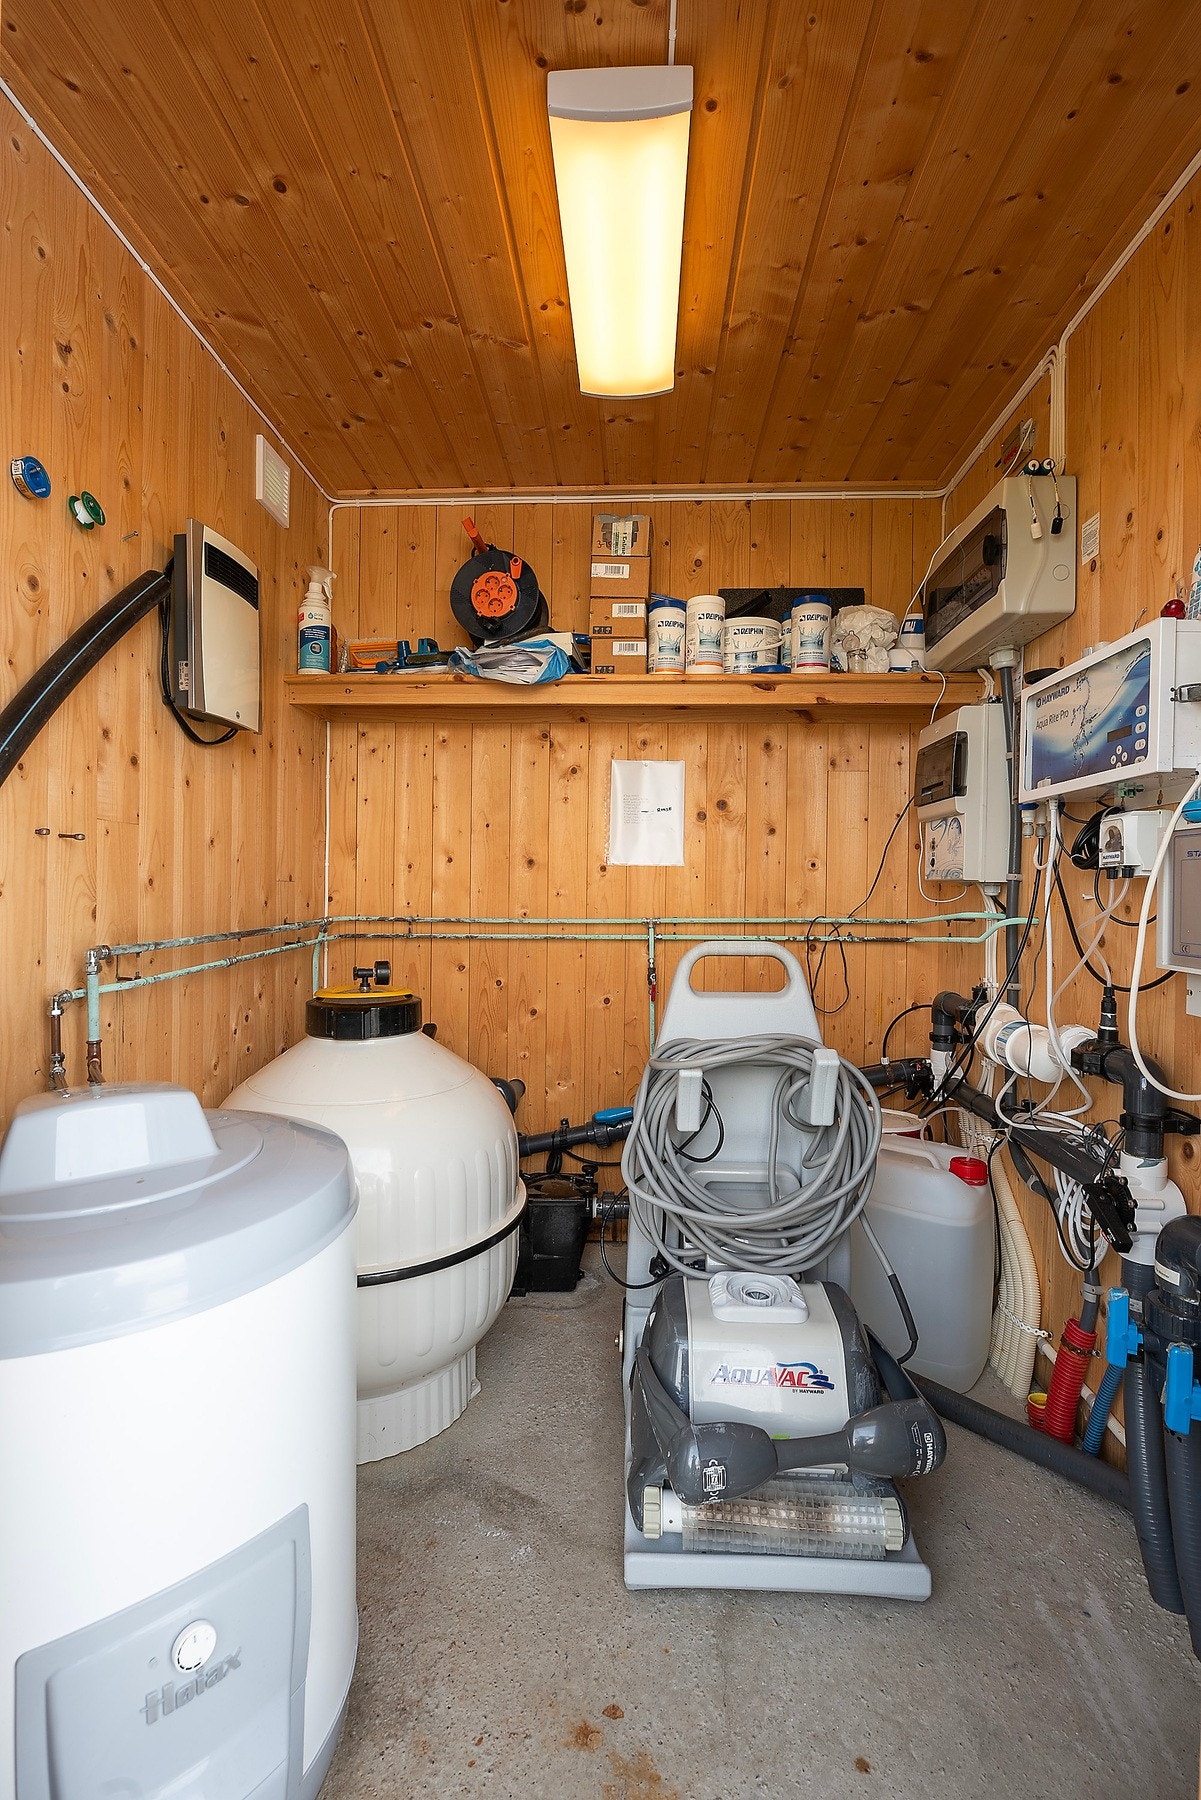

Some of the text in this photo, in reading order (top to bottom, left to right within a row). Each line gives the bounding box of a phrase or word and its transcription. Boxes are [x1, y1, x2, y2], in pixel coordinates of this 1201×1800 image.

[1041, 685, 1070, 706] HAYWARD
[1035, 709, 1069, 731] Aqua Rite Pro
